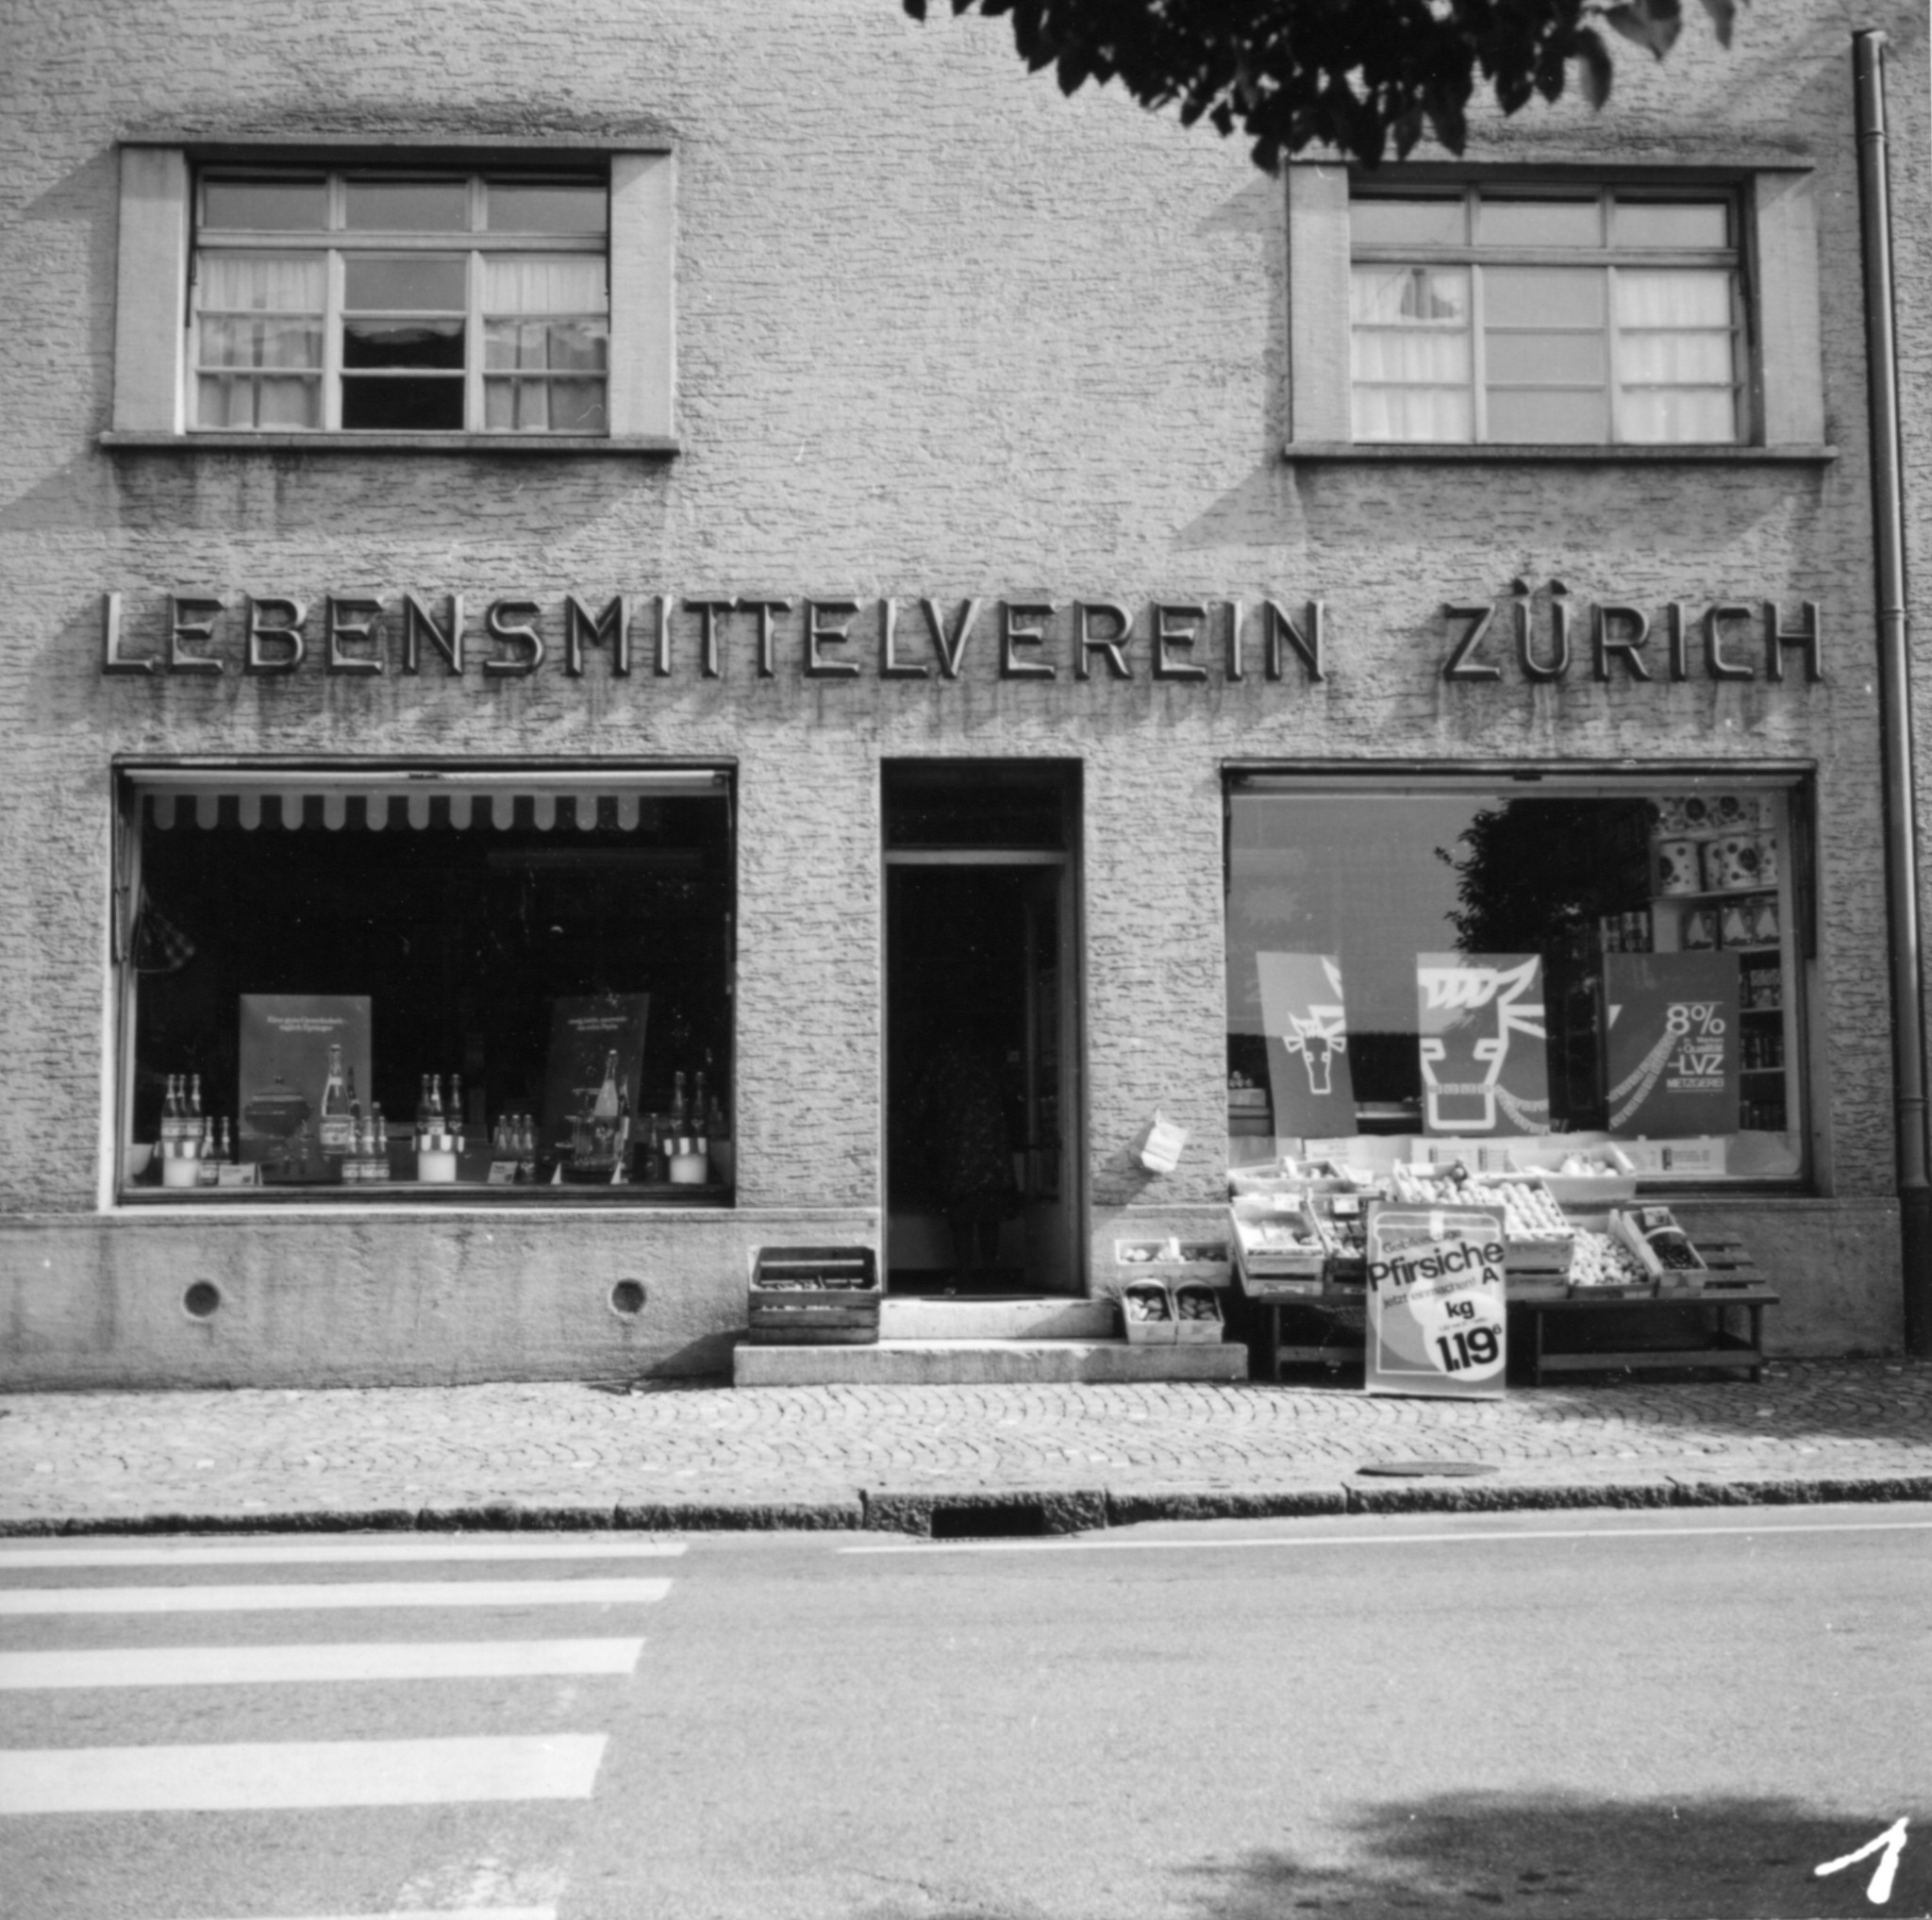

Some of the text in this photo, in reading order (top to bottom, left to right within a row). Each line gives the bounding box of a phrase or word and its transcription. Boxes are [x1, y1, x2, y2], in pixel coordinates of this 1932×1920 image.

[102, 578, 1823, 682] LEBENSMITTELVEREIN ZÜRICH
[1666, 1004, 1725, 1034] 8%
[1666, 1077, 1724, 1088] METZGEREI
[1368, 1242, 1505, 1293] Pfirsiche
[1482, 1266, 1500, 1284] A
[1444, 1300, 1475, 1319] kg
